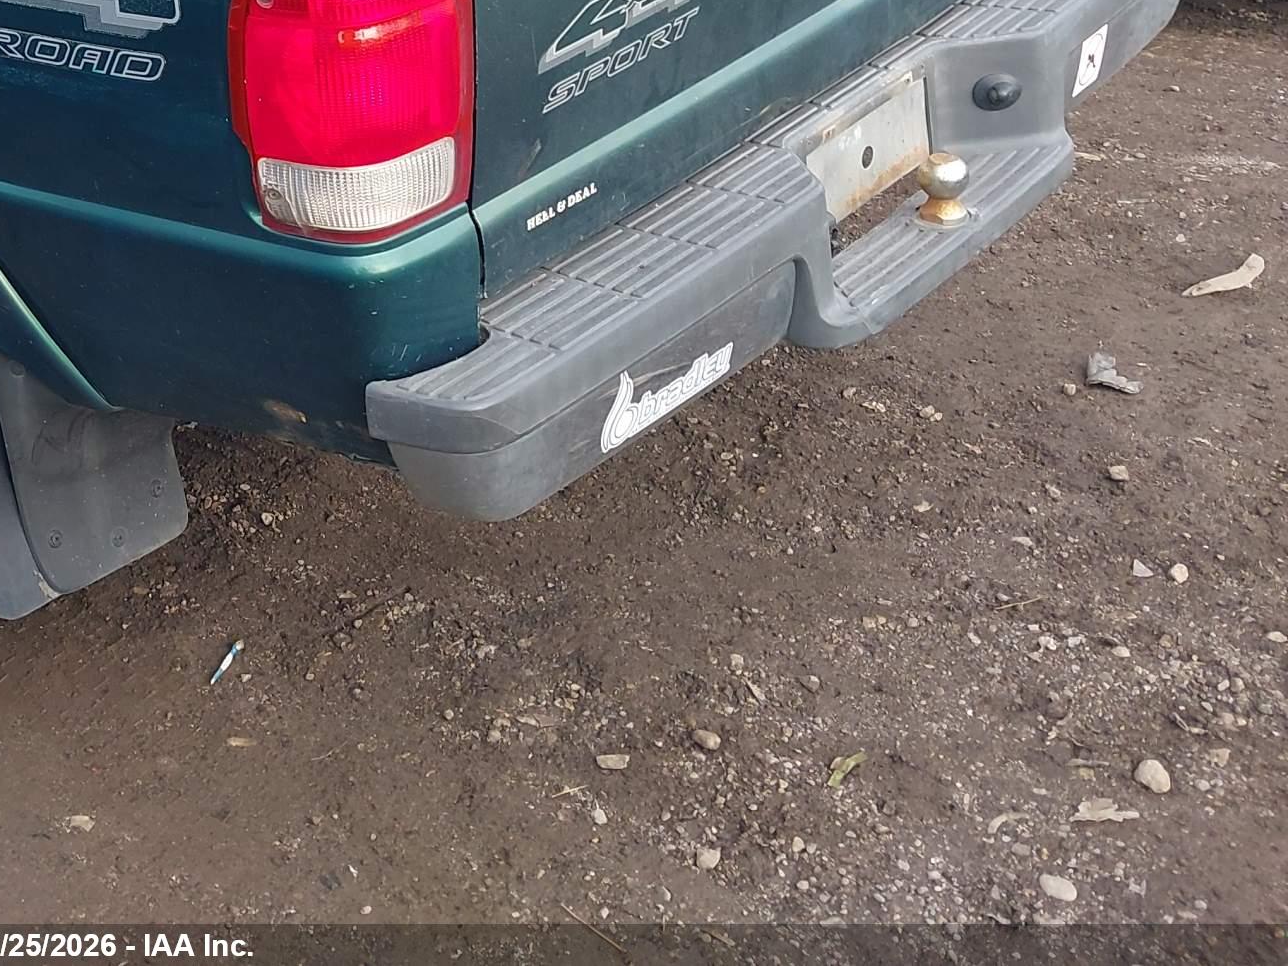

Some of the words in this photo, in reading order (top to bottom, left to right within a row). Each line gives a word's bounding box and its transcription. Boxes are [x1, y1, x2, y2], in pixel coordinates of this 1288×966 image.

[542, 6, 701, 115] SPORT
[556, 199, 567, 213] &
[567, 182, 598, 208] DEAL
